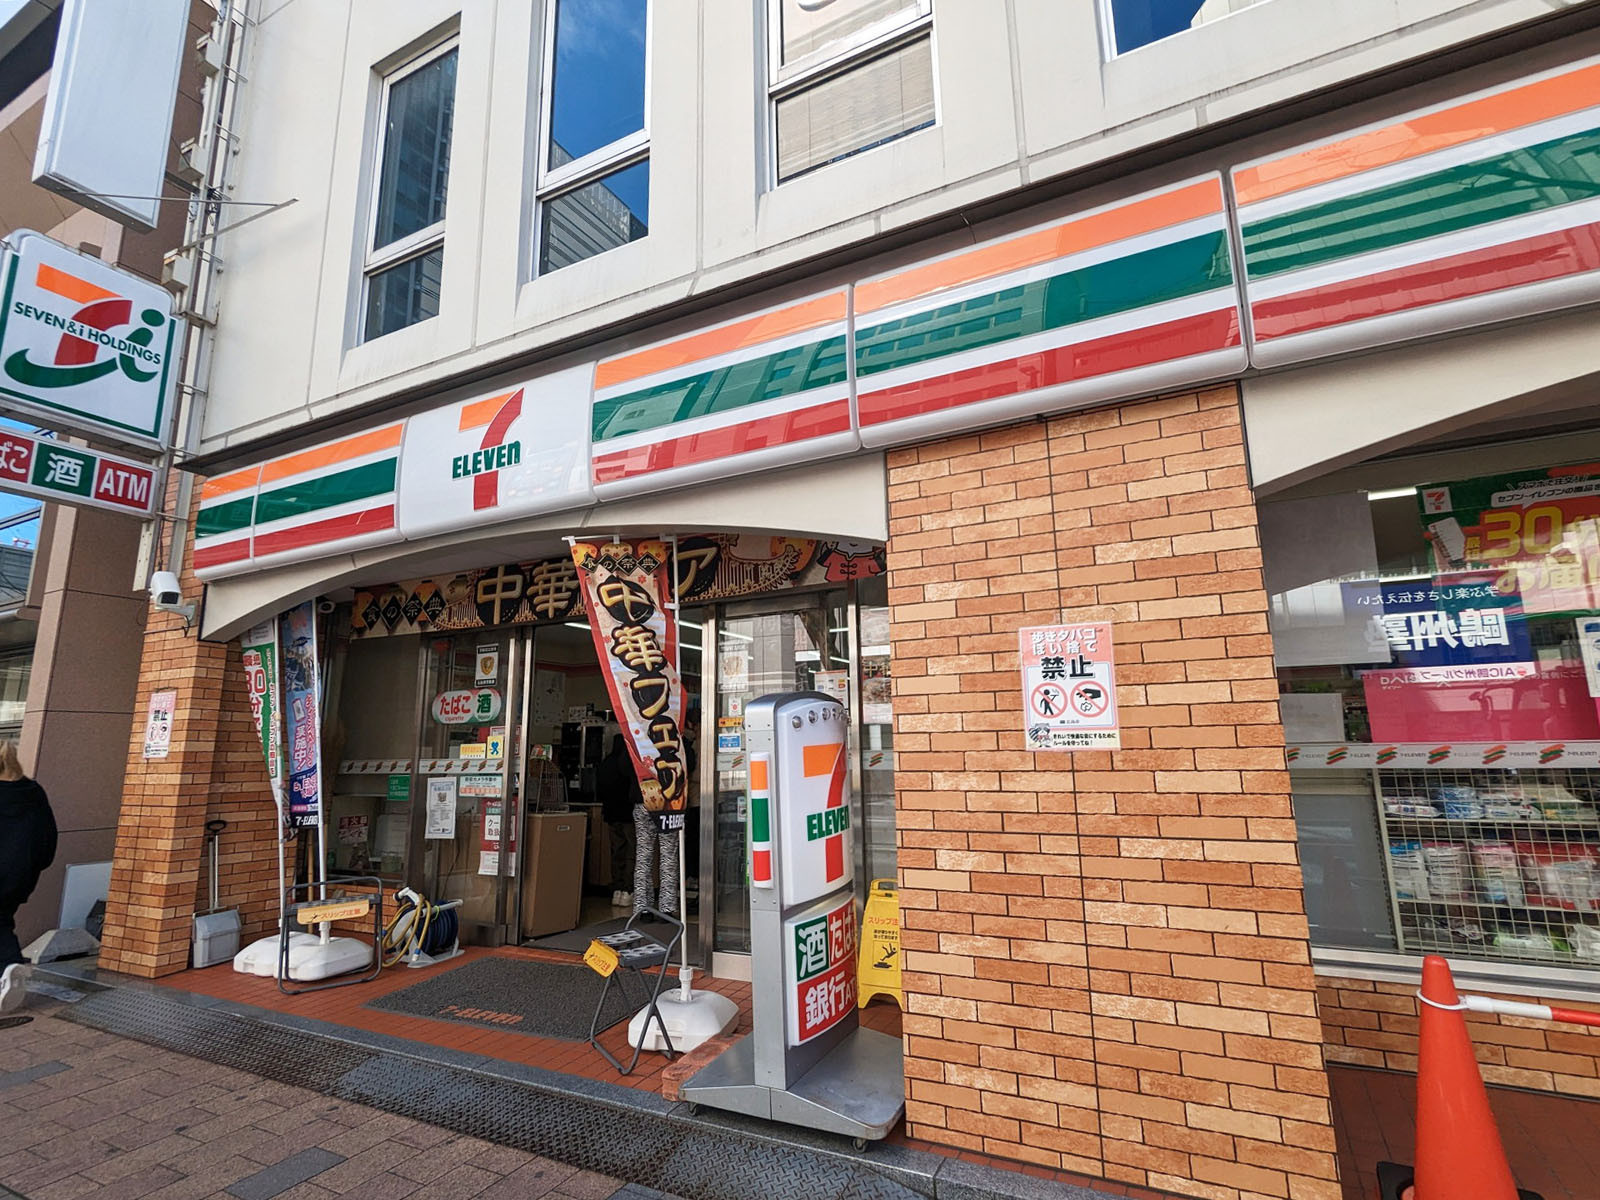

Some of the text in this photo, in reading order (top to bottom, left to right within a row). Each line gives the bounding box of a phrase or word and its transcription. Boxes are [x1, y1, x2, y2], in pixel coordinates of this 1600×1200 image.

[14, 302, 162, 365] SEVEN&i HOLDINGS
[44, 453, 85, 488] 酒
[100, 467, 149, 504] ATM
[367, 597, 443, 622] 食の祭典
[1041, 654, 1095, 680] 禁止
[440, 693, 492, 716] たばこ 酒
[798, 921, 827, 978] 酒
